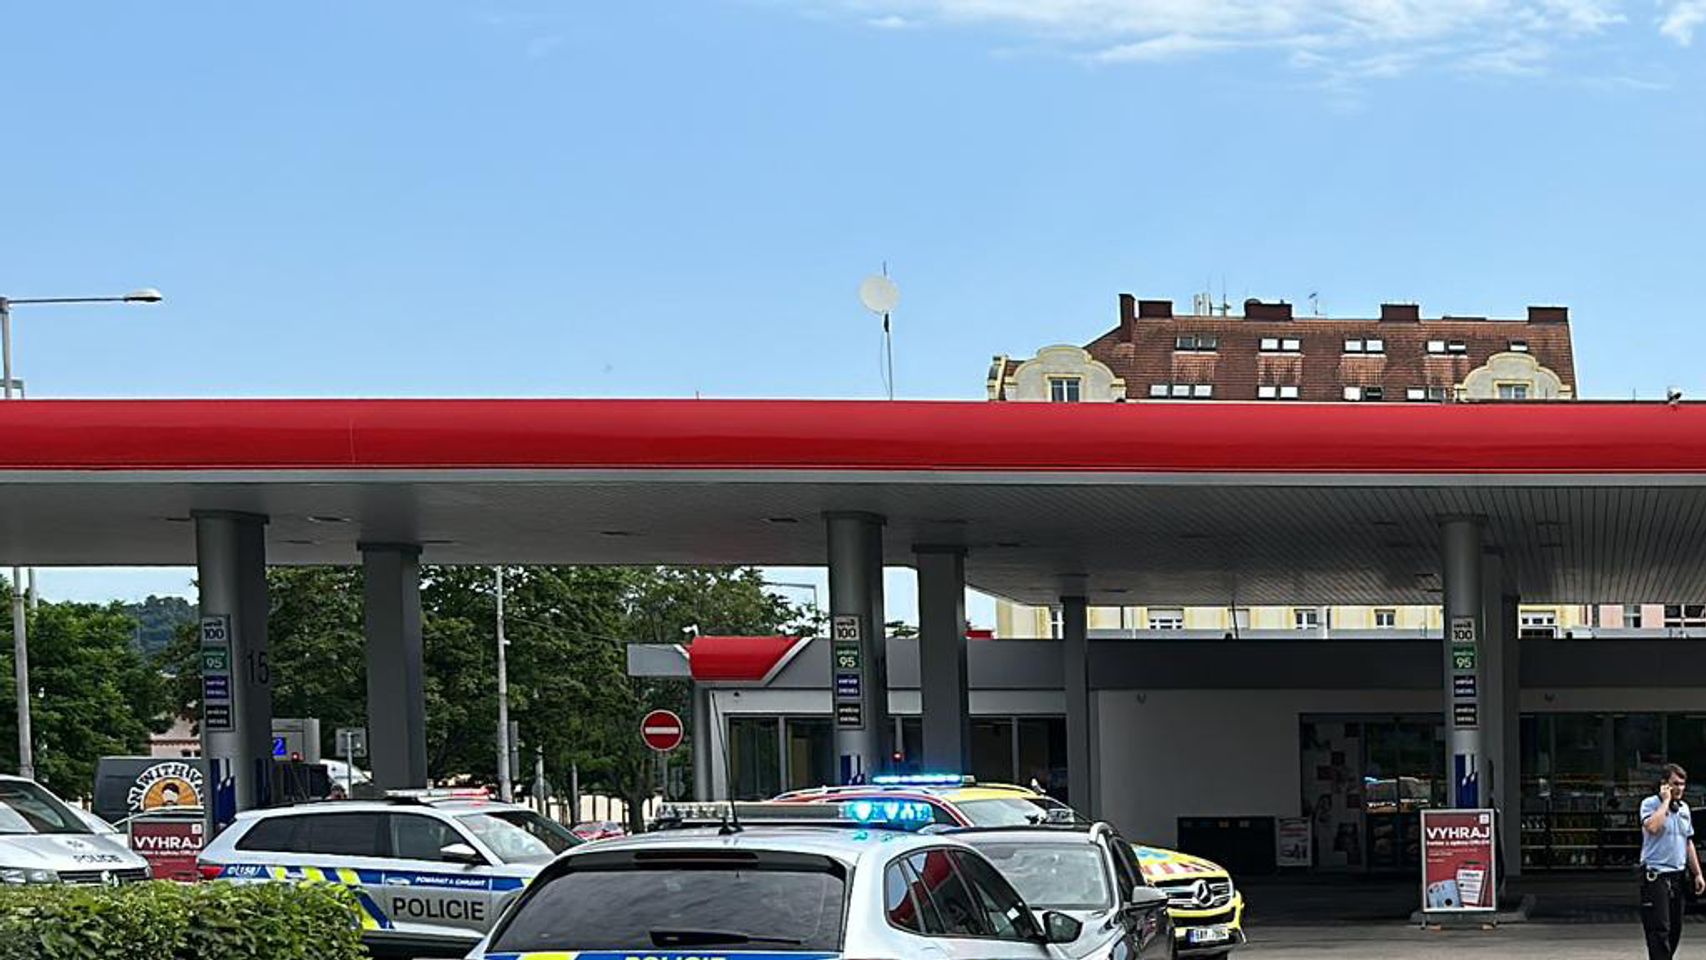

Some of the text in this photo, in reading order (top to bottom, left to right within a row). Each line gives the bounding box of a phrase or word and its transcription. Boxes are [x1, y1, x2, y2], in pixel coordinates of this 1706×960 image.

[204, 628, 225, 640] 100
[837, 628, 857, 638] 100
[1454, 630, 1473, 640] 100
[206, 657, 223, 669] 95
[247, 649, 269, 684] 15
[839, 656, 857, 668] 95
[1456, 656, 1473, 668] 95
[272, 737, 287, 756] 2
[1426, 827, 1490, 839] VYHRAJ
[134, 837, 203, 849] VYHRAJ
[392, 897, 485, 921] POLICIE
